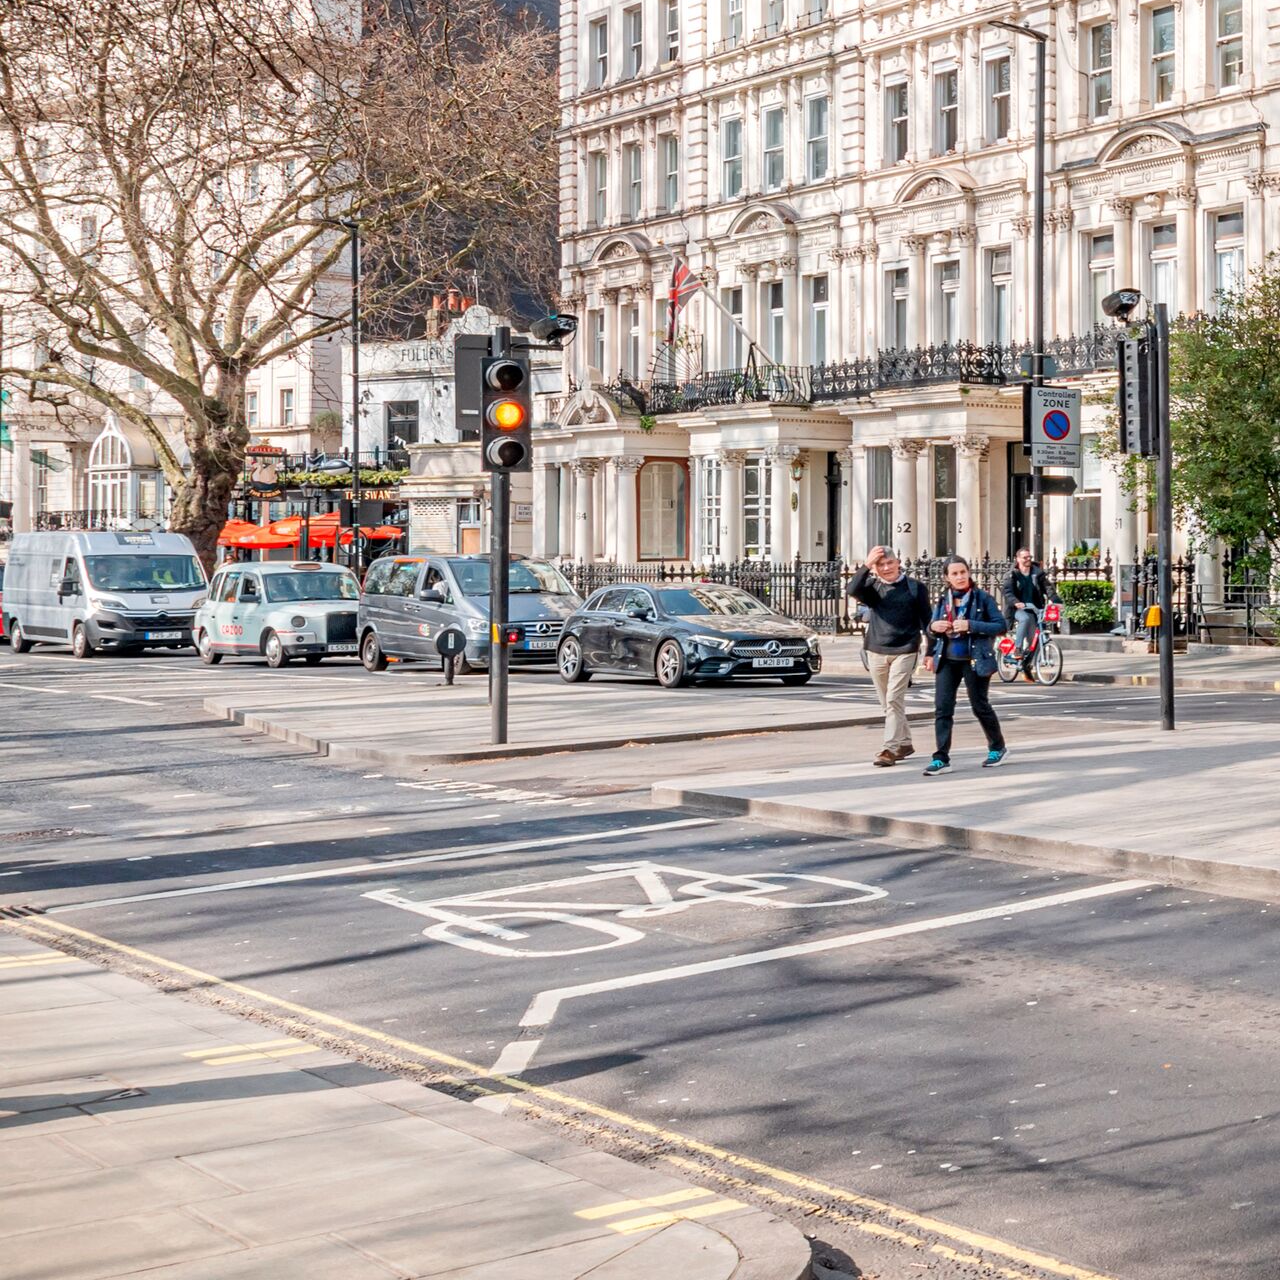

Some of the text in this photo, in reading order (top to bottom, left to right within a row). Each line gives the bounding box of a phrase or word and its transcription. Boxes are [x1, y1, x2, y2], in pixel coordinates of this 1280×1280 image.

[1037, 390, 1076, 399] Controlled
[1043, 399, 1070, 408] ZONE
[365, 491, 391, 500] SWAN
[897, 523, 912, 533] 62
